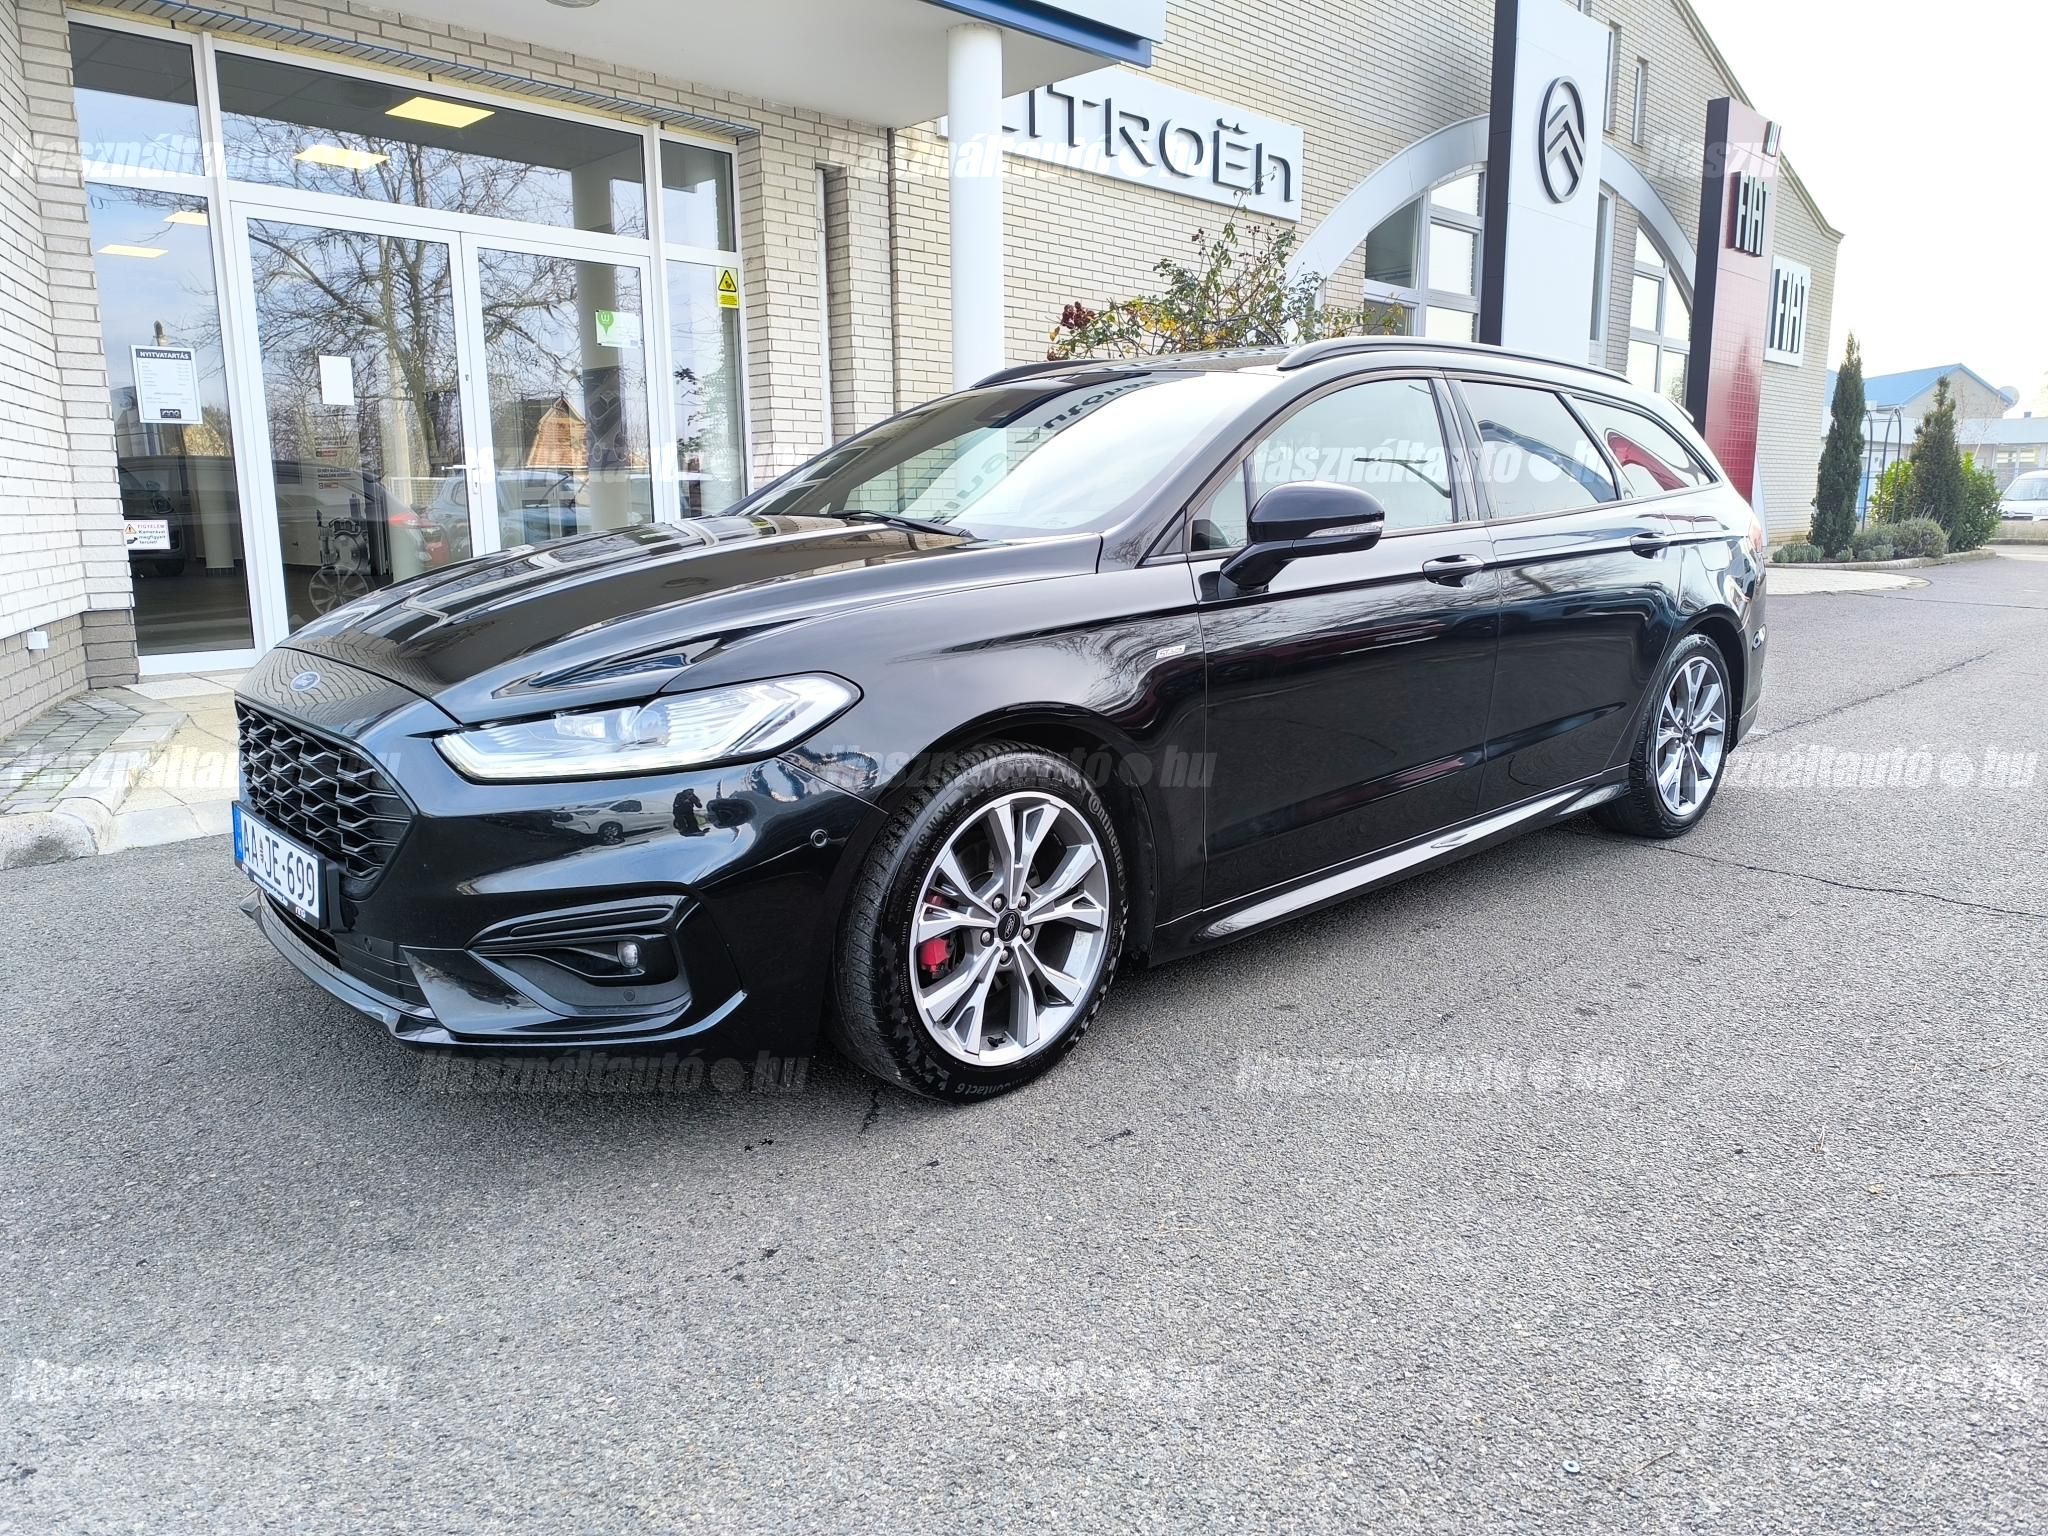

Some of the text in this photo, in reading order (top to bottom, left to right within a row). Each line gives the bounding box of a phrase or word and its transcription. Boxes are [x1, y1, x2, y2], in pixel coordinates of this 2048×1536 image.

[1735, 171, 1769, 257] FIAT
[1771, 269, 1810, 354] FIAT
[140, 351, 189, 359] NYITVATARTÁS
